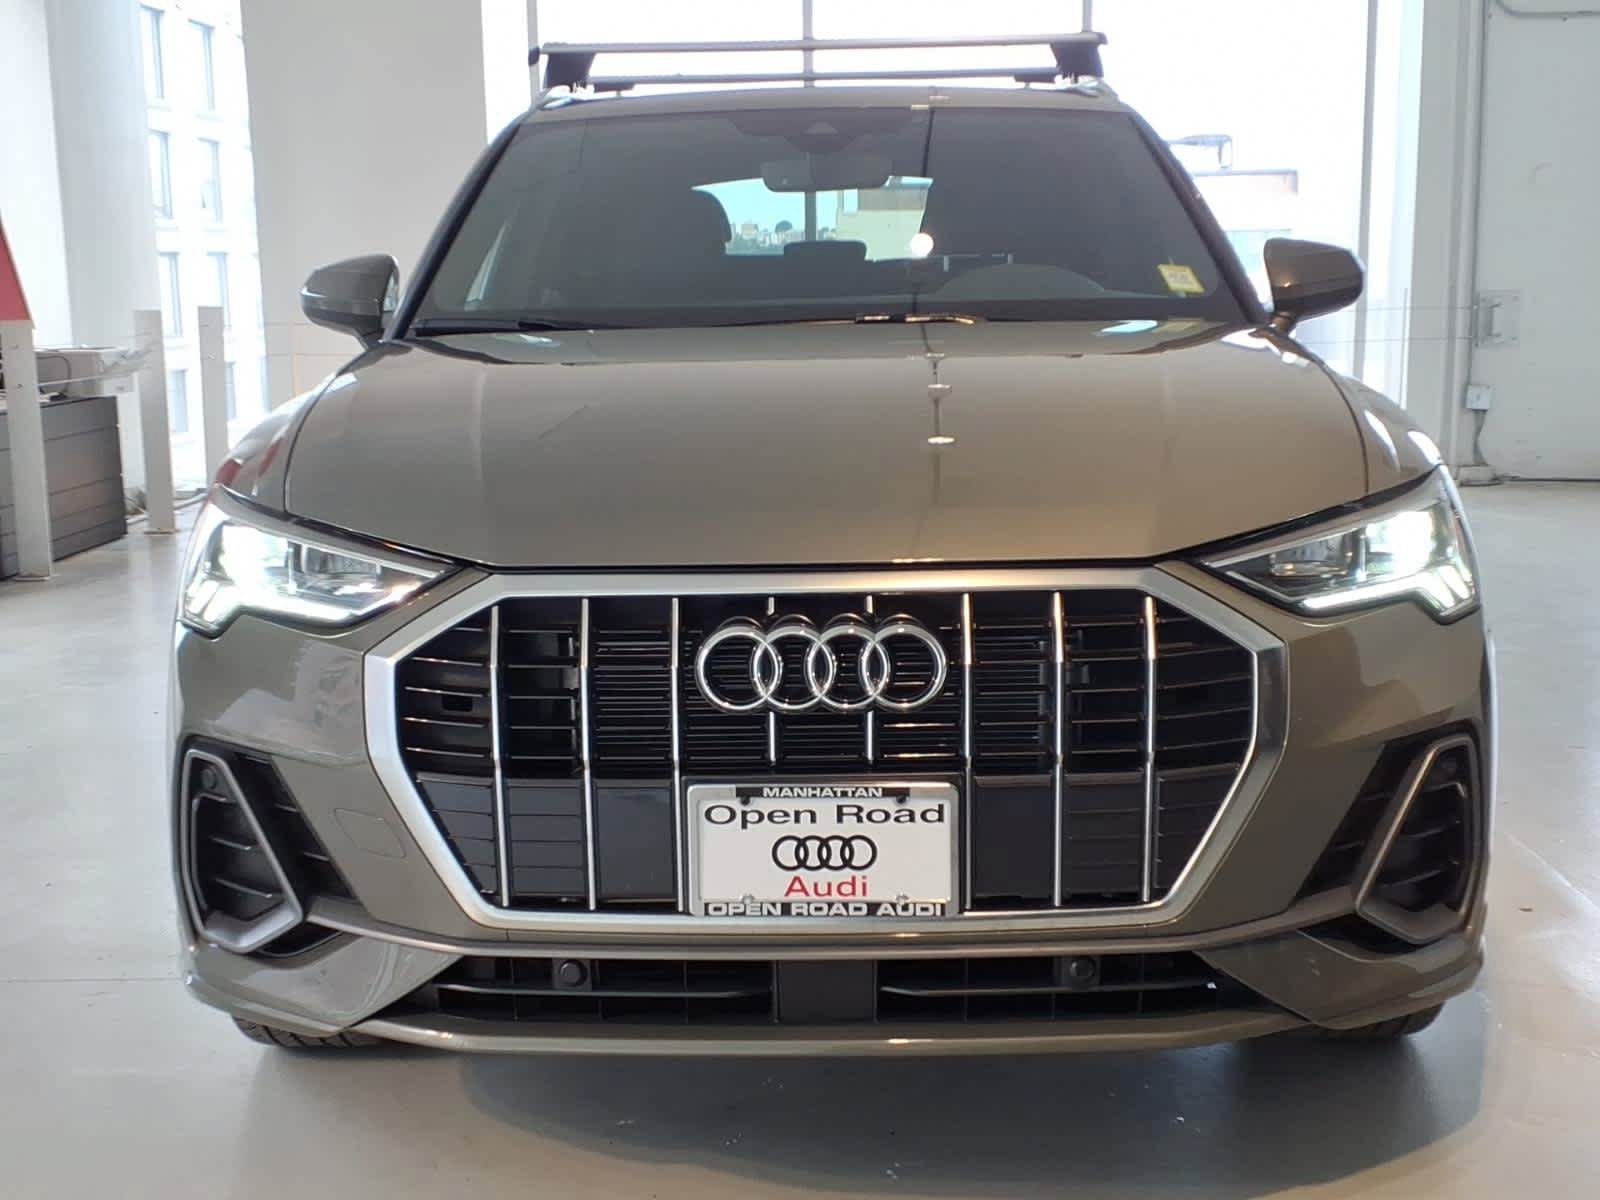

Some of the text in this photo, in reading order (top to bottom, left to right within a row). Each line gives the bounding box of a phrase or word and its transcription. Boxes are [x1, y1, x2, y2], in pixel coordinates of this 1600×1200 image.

[763, 787, 883, 798] MANHATTAN
[704, 803, 945, 830] Open Road
[784, 875, 868, 898] Audi
[708, 902, 942, 917] OPEN ROAD AUDI
